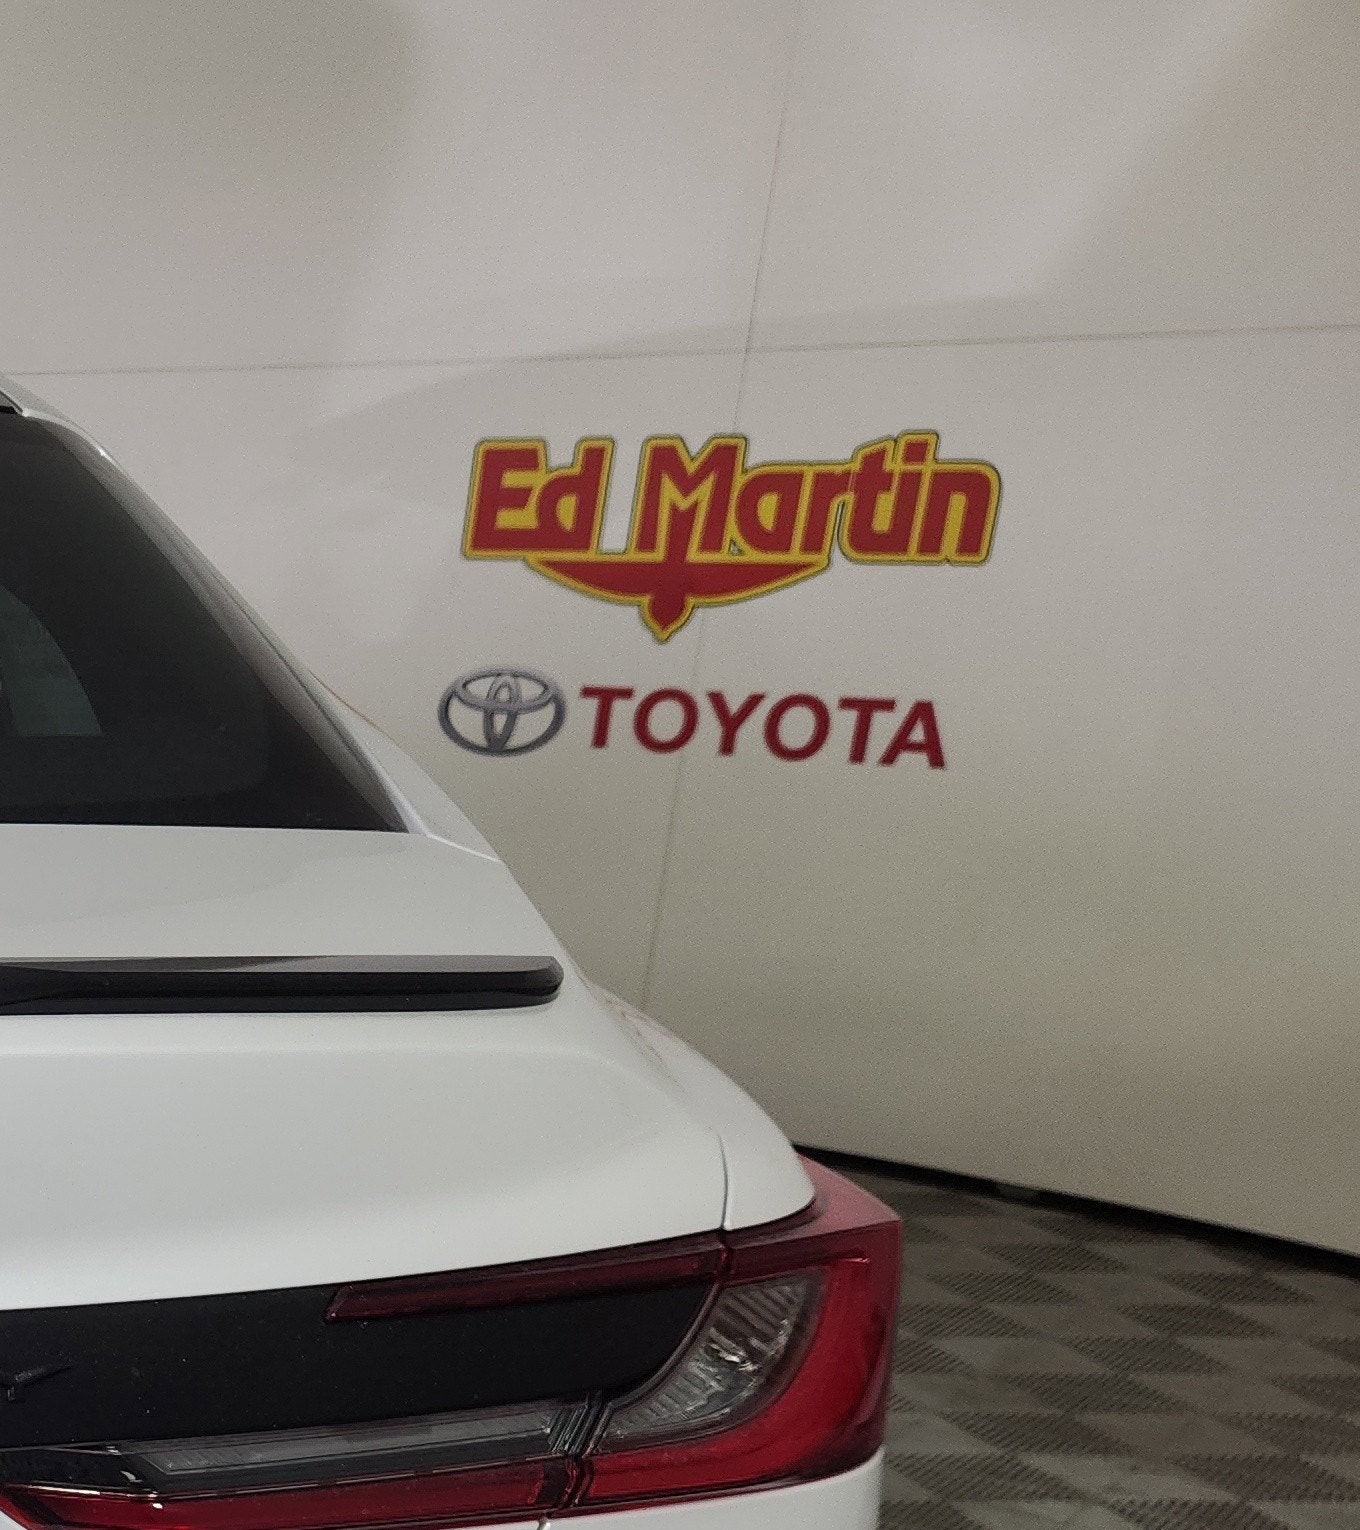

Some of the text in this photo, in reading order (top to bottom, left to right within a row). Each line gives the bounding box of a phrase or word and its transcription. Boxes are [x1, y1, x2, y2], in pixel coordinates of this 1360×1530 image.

[462, 431, 1000, 566] Ed Martin
[581, 684, 947, 771] TOYOTA
